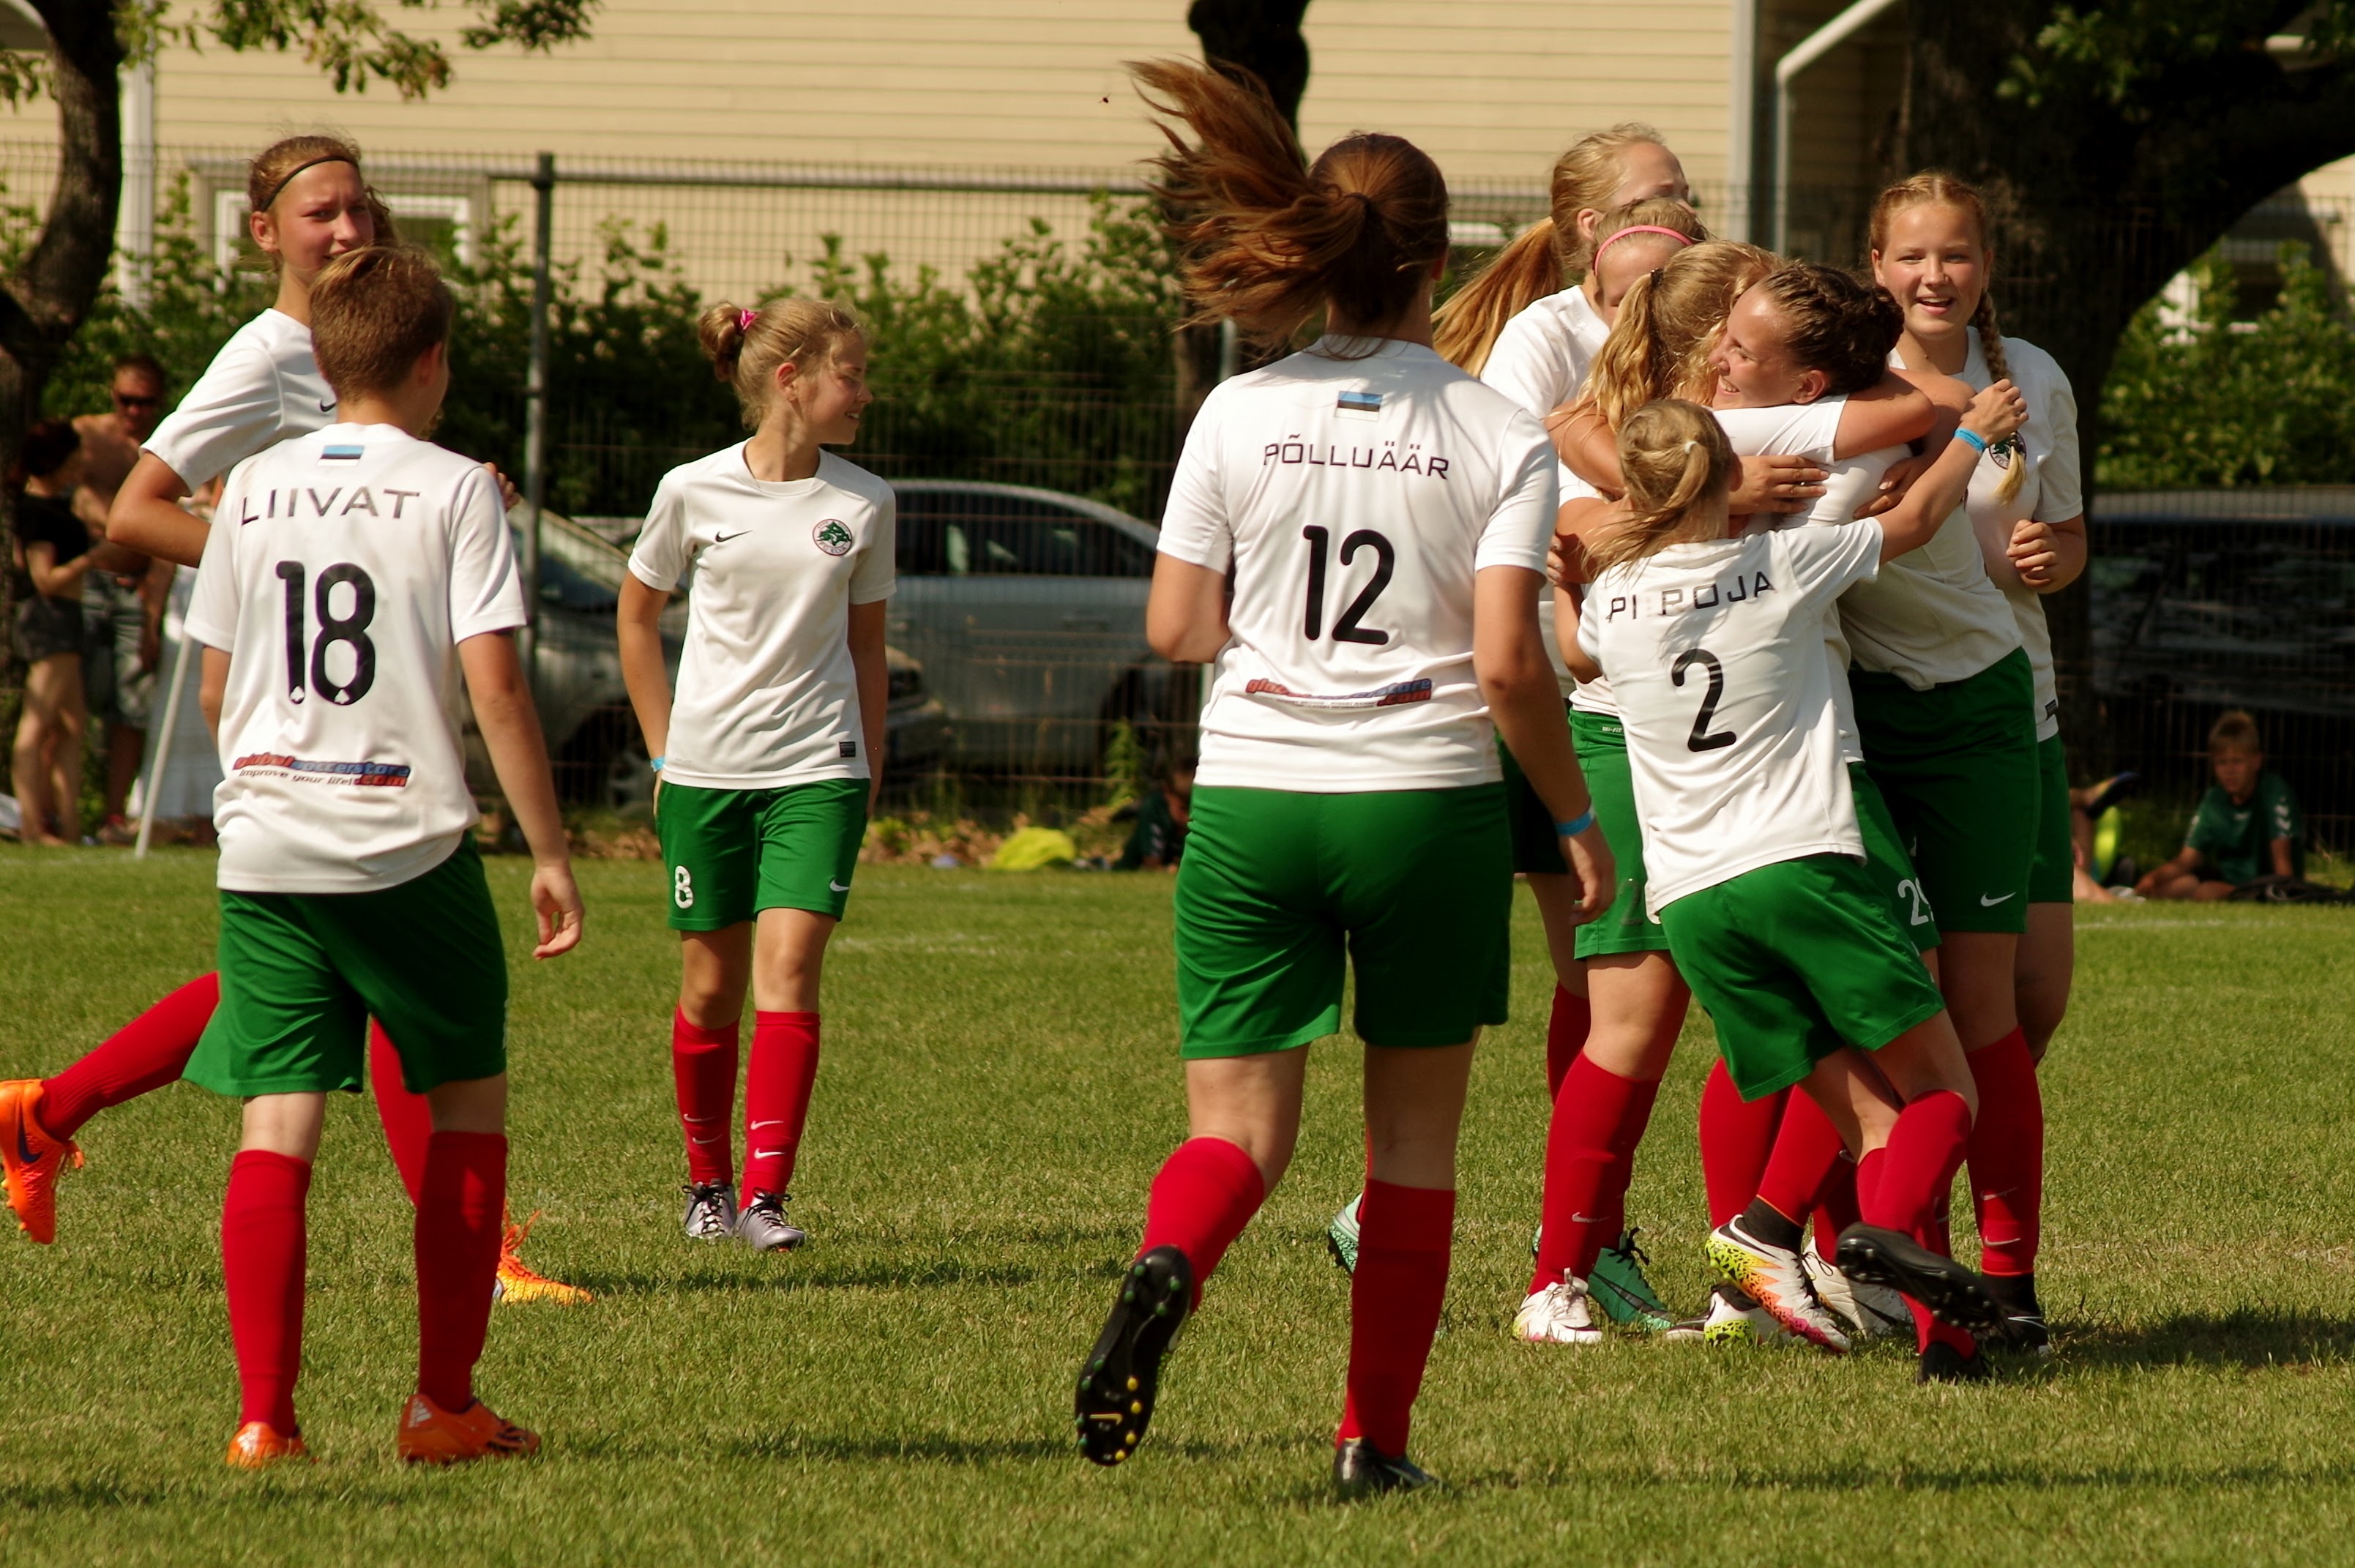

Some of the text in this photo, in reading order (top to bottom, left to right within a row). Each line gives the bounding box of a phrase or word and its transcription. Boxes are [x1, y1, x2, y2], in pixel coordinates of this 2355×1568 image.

[1264, 433, 1449, 480] PÕLLUÄÄR
[241, 486, 420, 526] LIIVAT
[1302, 524, 1395, 646] 12
[275, 560, 376, 706] 18
[1671, 649, 1736, 752] 2
[674, 865, 694, 909] 8
